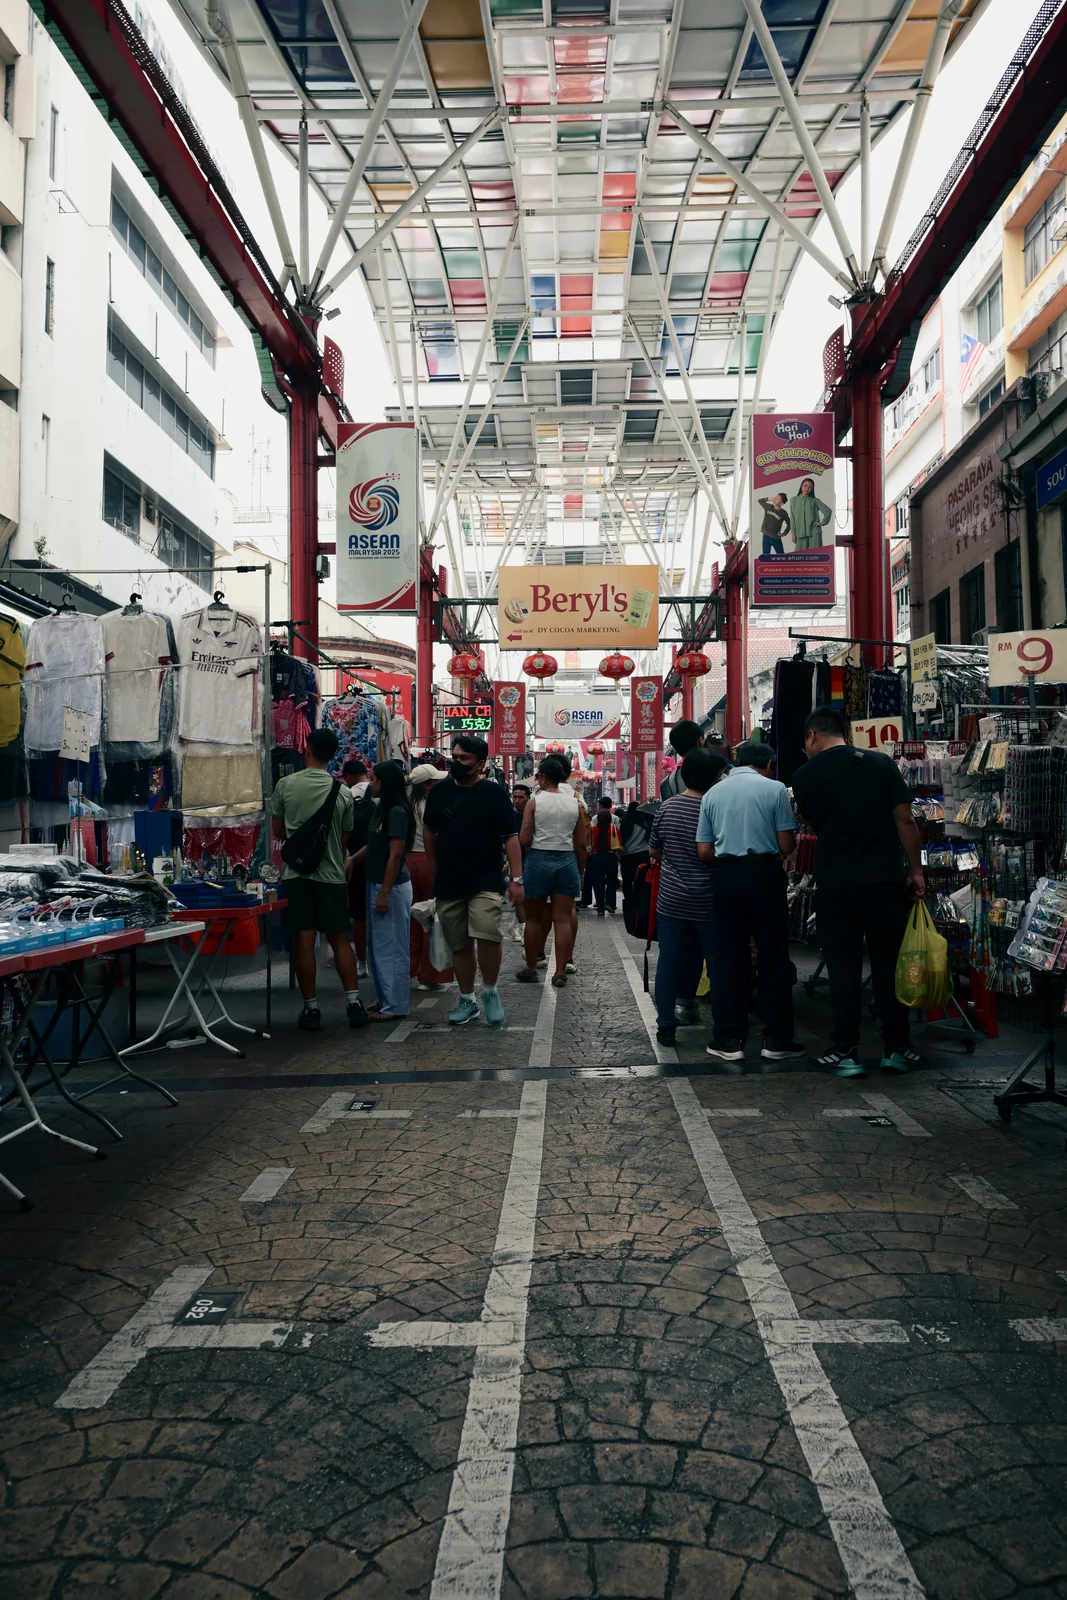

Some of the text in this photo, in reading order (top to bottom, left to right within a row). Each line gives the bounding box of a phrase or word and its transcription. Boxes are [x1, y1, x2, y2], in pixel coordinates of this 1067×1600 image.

[777, 422, 798, 433] Hari
[788, 430, 809, 441] Hari
[947, 456, 993, 511] PASARAYA
[1047, 463, 1067, 491] SOU
[348, 534, 400, 549] ASEAN
[529, 583, 628, 623] Beryl's
[191, 651, 236, 668] Emirates
[997, 637, 1053, 675] RM 9
[571, 710, 603, 720] ASEAN
[855, 723, 899, 749] RM 10
